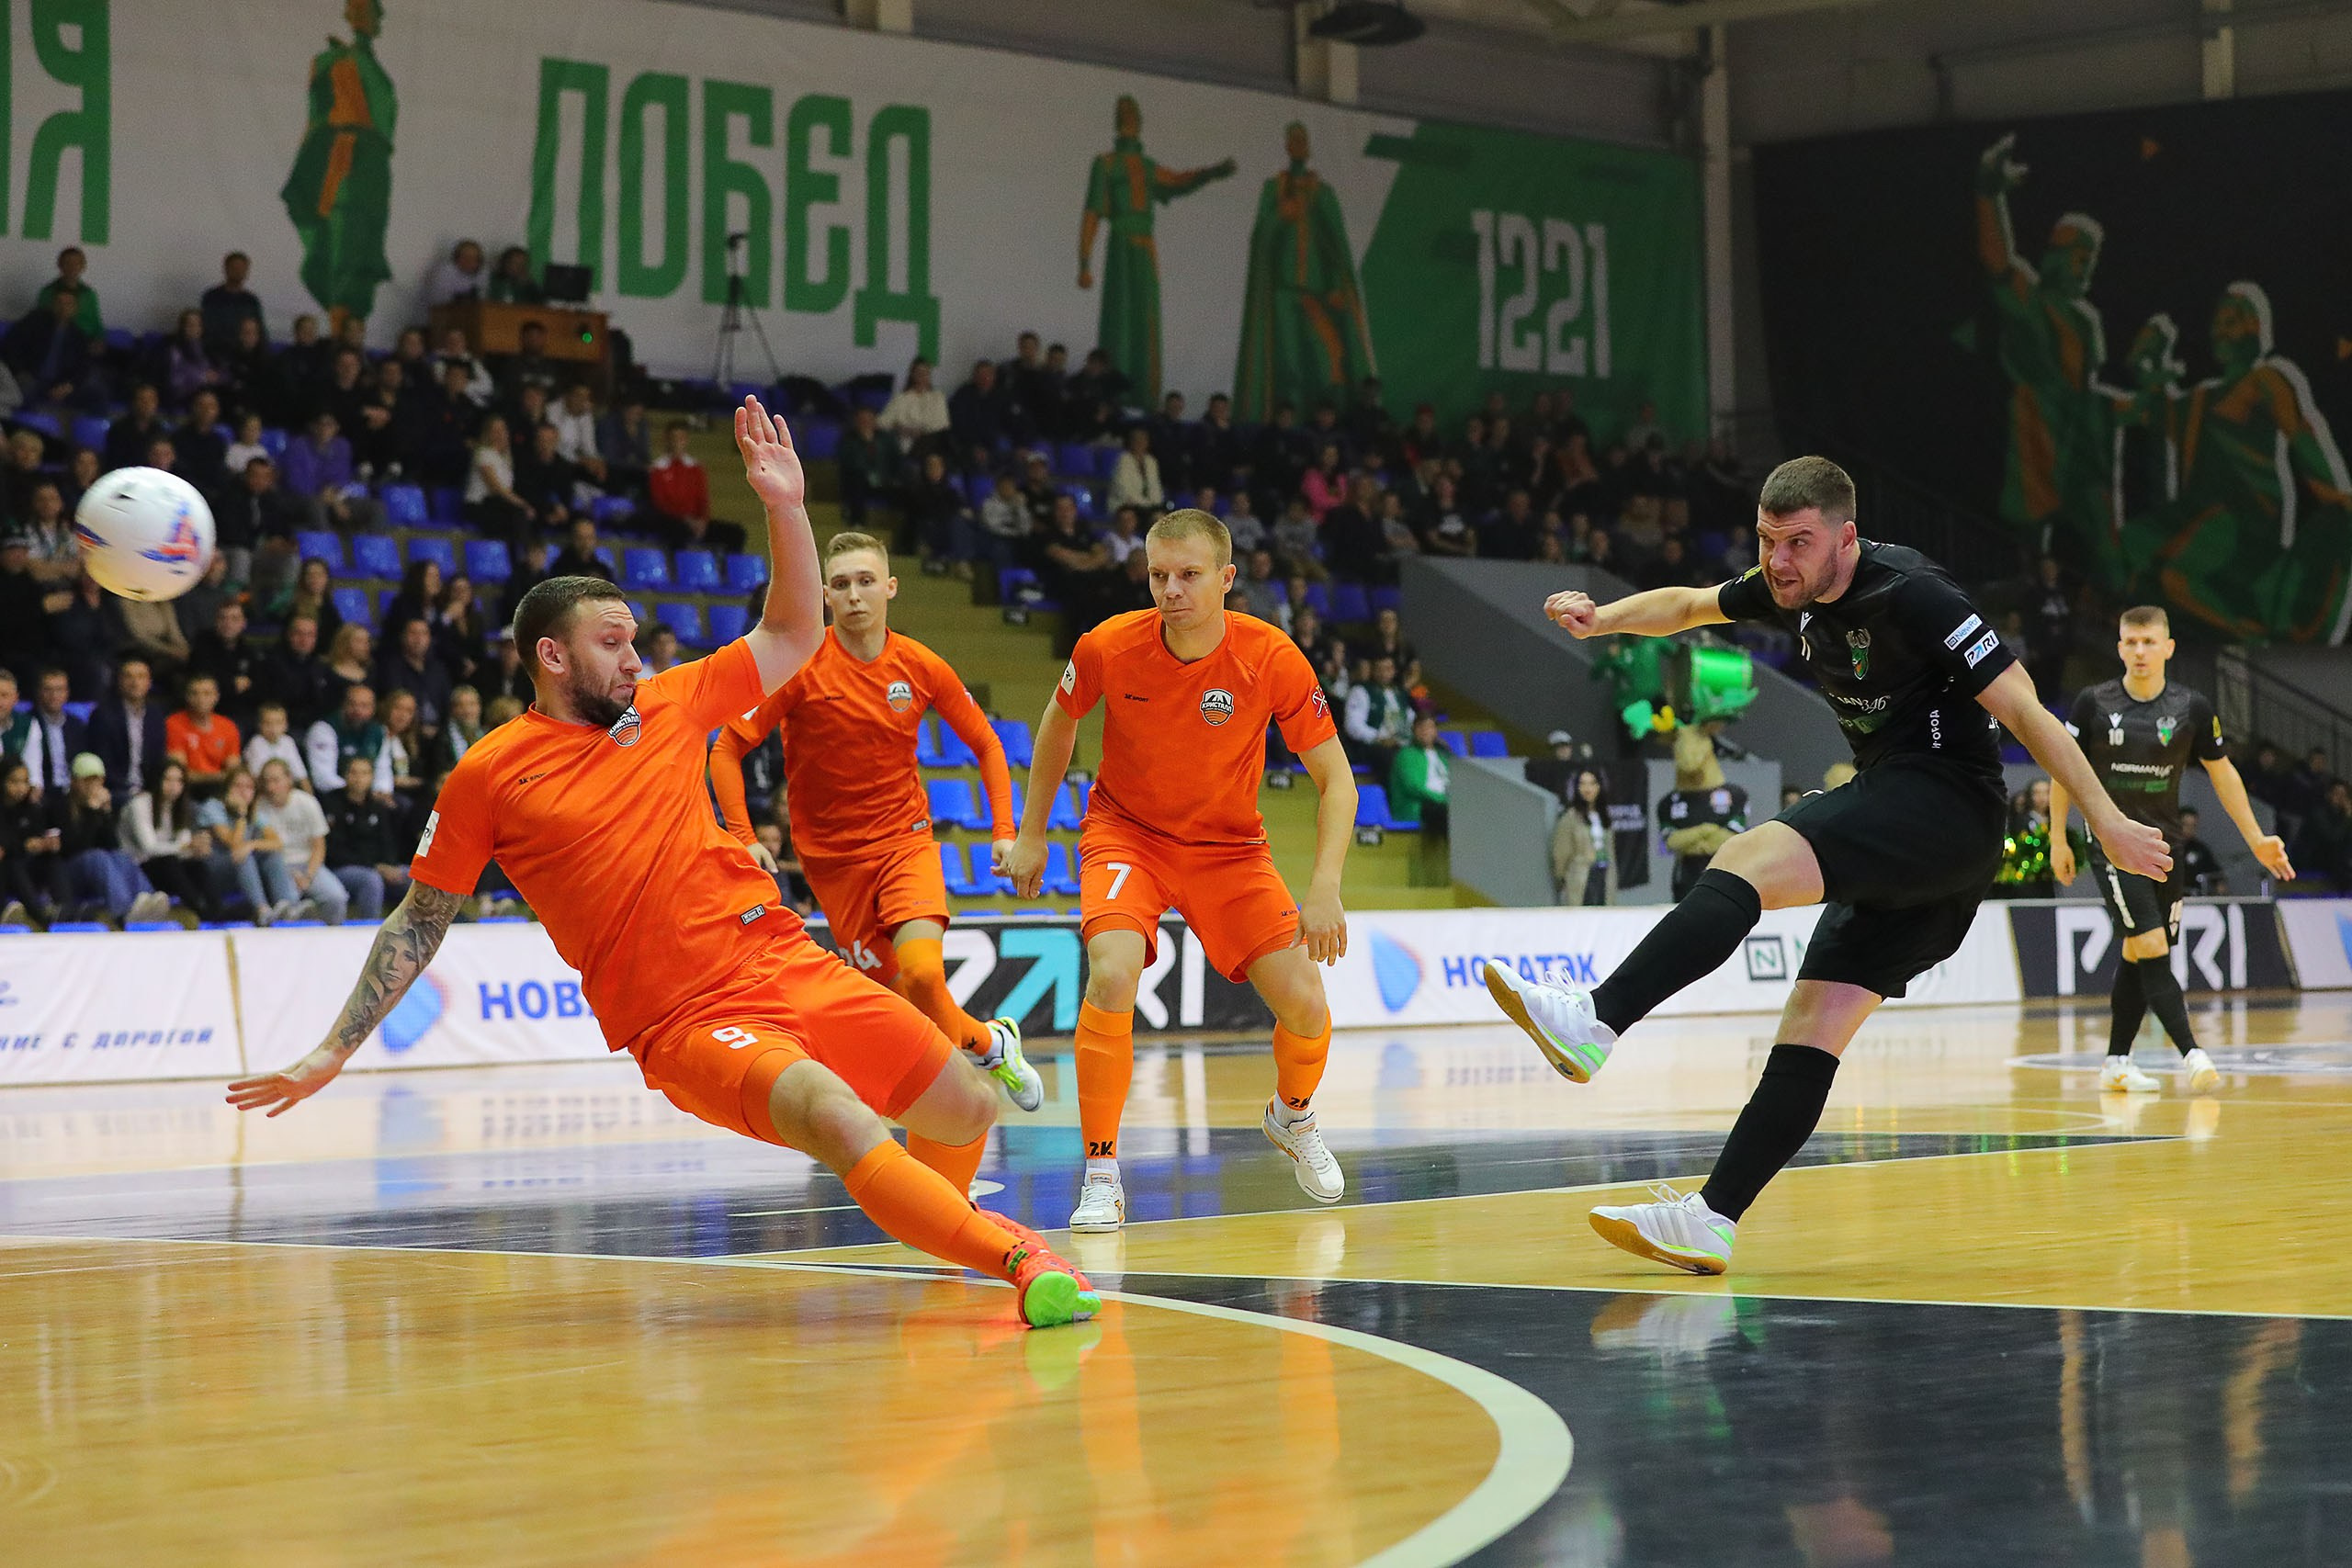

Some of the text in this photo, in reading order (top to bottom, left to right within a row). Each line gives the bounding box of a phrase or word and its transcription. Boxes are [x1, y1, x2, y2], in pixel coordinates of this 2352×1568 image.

[0, 0, 110, 245] Я
[527, 56, 941, 367] ПОБЕД
[1471, 208, 1611, 378] 1221
[1967, 634, 1996, 665] PARI
[1202, 702, 1232, 713] КРИСТАЛЛ
[2109, 728, 2124, 746] 10
[1105, 862, 1132, 900] 7
[2055, 903, 2247, 997] PRI
[1442, 953, 1600, 988] НОАТЭК
[478, 978, 595, 1021] НОВ
[712, 1026, 759, 1049] 9
[1089, 1140, 1114, 1156] 2K
